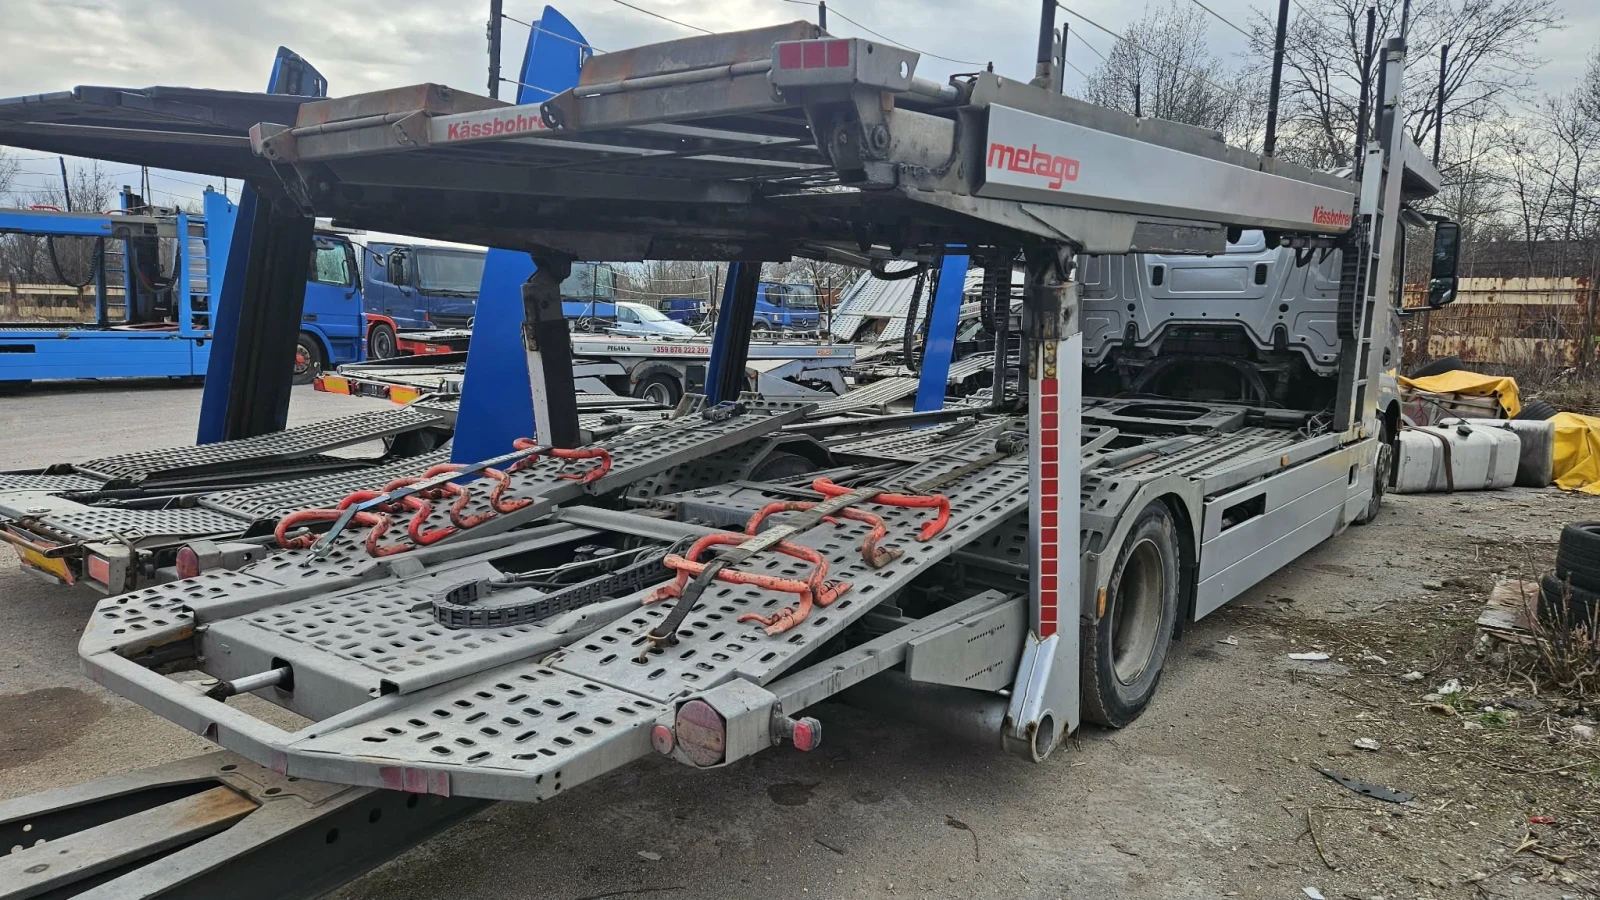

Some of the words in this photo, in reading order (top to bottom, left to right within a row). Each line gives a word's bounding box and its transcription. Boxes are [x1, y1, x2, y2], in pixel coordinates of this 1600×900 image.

[987, 143, 1080, 190] metago
[1312, 205, 1352, 227] Kässbohrer
[670, 346, 681, 354] 878
[683, 346, 696, 354] 222
